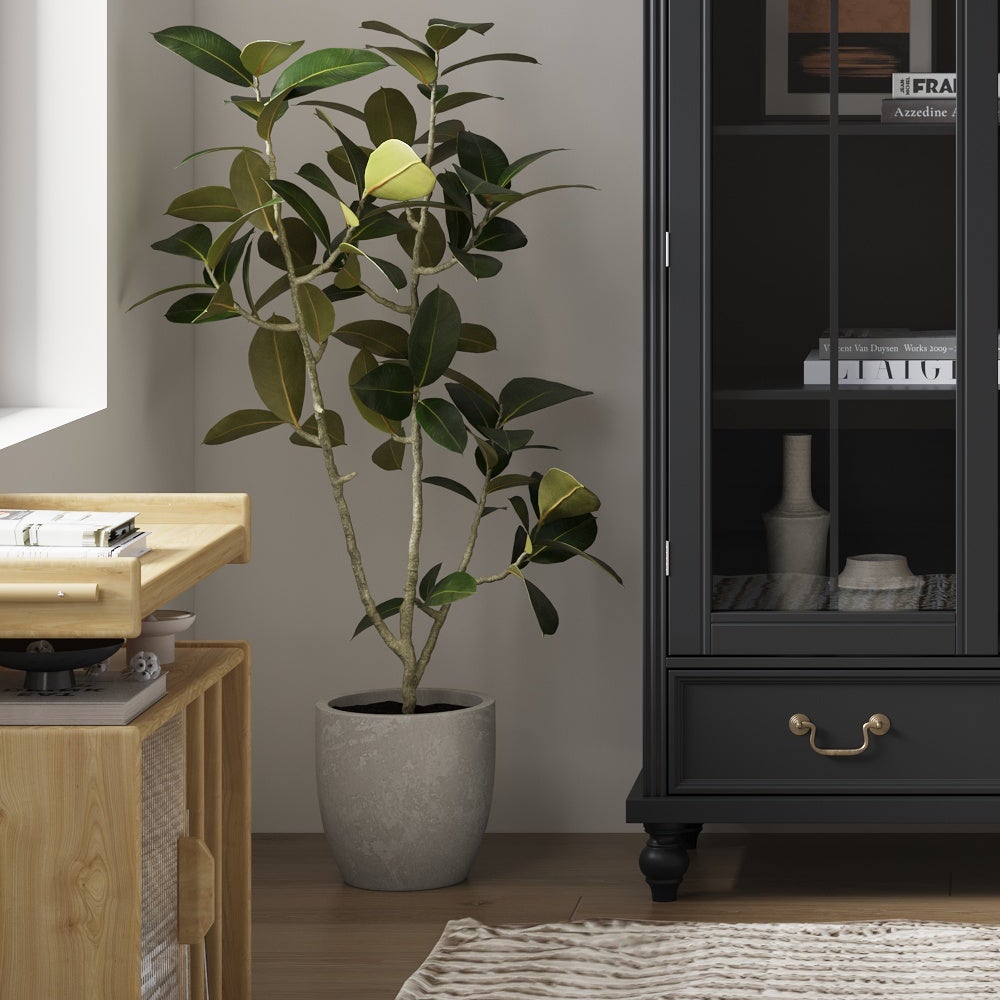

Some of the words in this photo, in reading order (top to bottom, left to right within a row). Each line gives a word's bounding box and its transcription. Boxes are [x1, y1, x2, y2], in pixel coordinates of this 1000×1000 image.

[894, 106, 948, 117] Azzedine
[854, 344, 868, 352] Van
[870, 344, 898, 354] Duysen
[904, 344, 927, 352] Works
